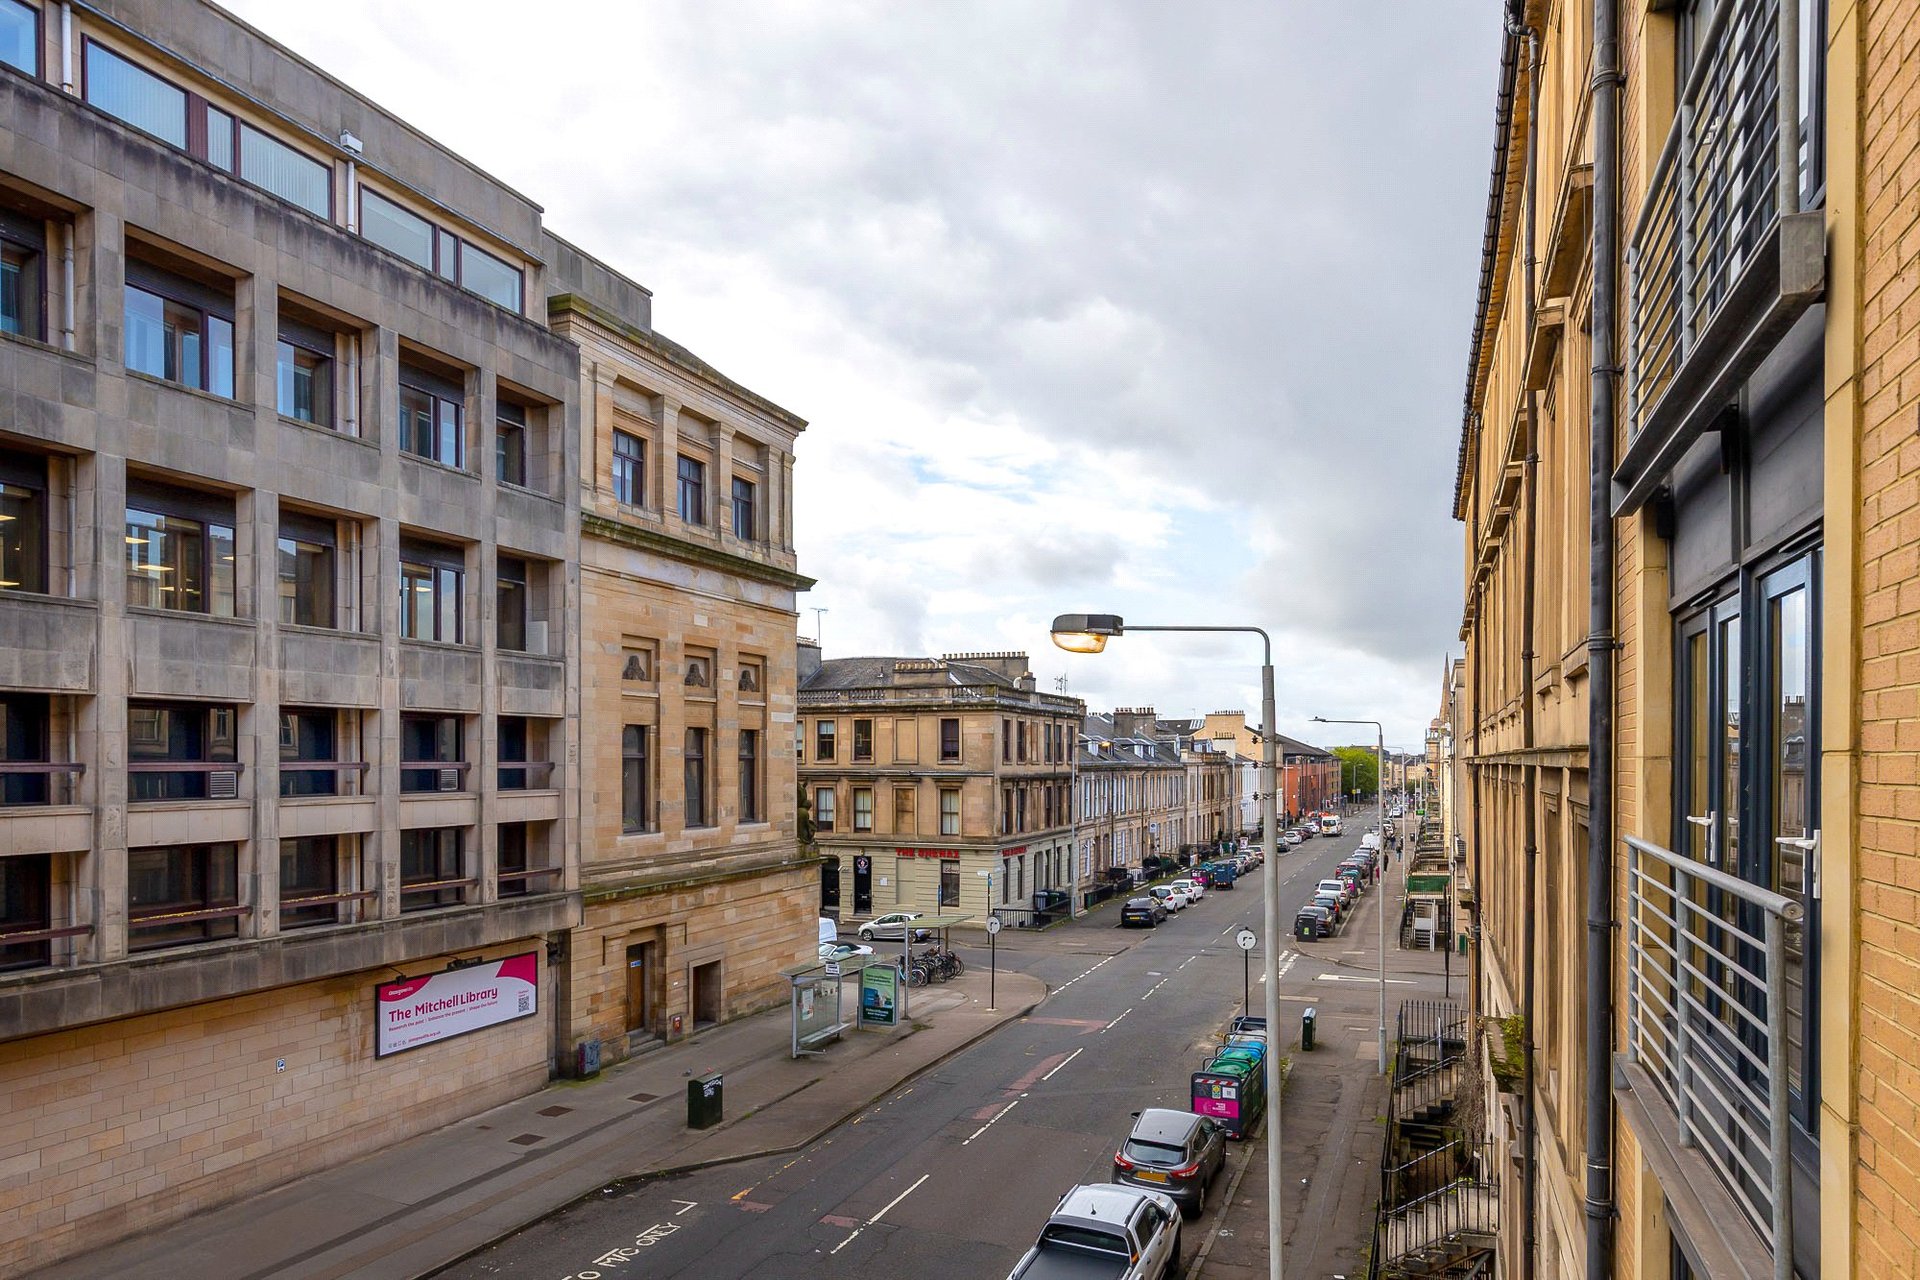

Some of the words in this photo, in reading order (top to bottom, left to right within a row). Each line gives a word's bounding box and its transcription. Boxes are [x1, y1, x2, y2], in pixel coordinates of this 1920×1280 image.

[388, 1009, 412, 1022] The
[415, 995, 459, 1017] Mitchell
[460, 988, 498, 1005] Library
[636, 1222, 681, 1246] ONLY
